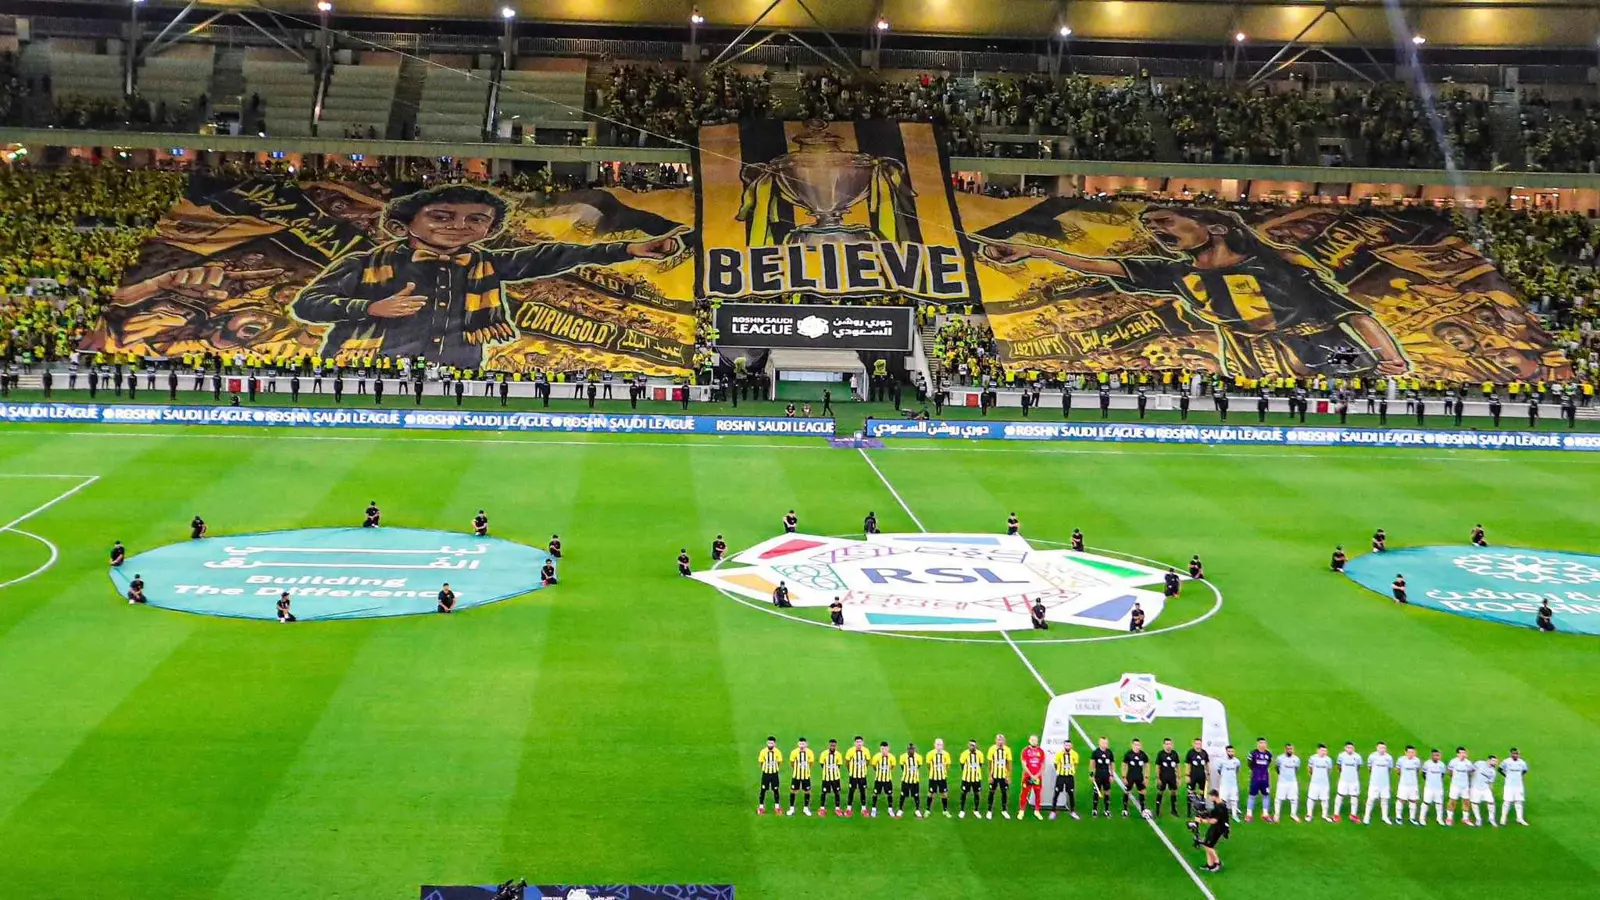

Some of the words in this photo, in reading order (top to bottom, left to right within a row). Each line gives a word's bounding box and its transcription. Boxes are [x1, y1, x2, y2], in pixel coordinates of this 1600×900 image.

[705, 242, 969, 296] BELIEVE
[732, 316, 764, 324] ROSHN
[832, 316, 864, 327] روشن
[865, 318, 893, 328] دوري
[731, 324, 793, 335] LEAGUE
[832, 328, 893, 339] السعودي
[8, 406, 48, 418] SAUDI
[49, 407, 98, 419] LEAGUE
[115, 408, 161, 420] ROSHN
[163, 409, 201, 421] SAUDI
[203, 410, 252, 422] LEAGUE
[265, 410, 310, 423] ROSHN
[313, 411, 350, 423] SAUDI
[352, 412, 400, 424] LEAGUE
[416, 413, 461, 425] ROSHN
[463, 415, 501, 426] SAUDI
[503, 415, 550, 427] LEAGUE
[563, 416, 607, 427] ROSHN
[609, 417, 647, 428] SAUDI
[648, 418, 694, 430] LEAGUE
[716, 420, 756, 431] ROSHN
[757, 421, 792, 432] SAUDI
[793, 422, 834, 433] LEAGUE
[873, 422, 927, 436] السعودي
[928, 422, 960, 435] روشن
[961, 425, 989, 438] دوري
[1016, 425, 1059, 437] ROSHN
[1061, 426, 1097, 438] SAUDI
[1098, 427, 1144, 439] LEAGUE
[1155, 428, 1198, 440] ROSHN
[1200, 429, 1236, 441] SAUDI
[1237, 430, 1283, 442] LEAGUE
[1297, 430, 1340, 442] ROSHN
[1342, 431, 1378, 443] SAUDI
[1379, 432, 1424, 444] LEAGUE
[1478, 434, 1514, 446] SAUDI
[1515, 435, 1561, 447] LEAGUE
[246, 575, 408, 588] Building
[860, 567, 1031, 584] RSL
[174, 585, 244, 596] The
[1129, 693, 1147, 702] RSL
